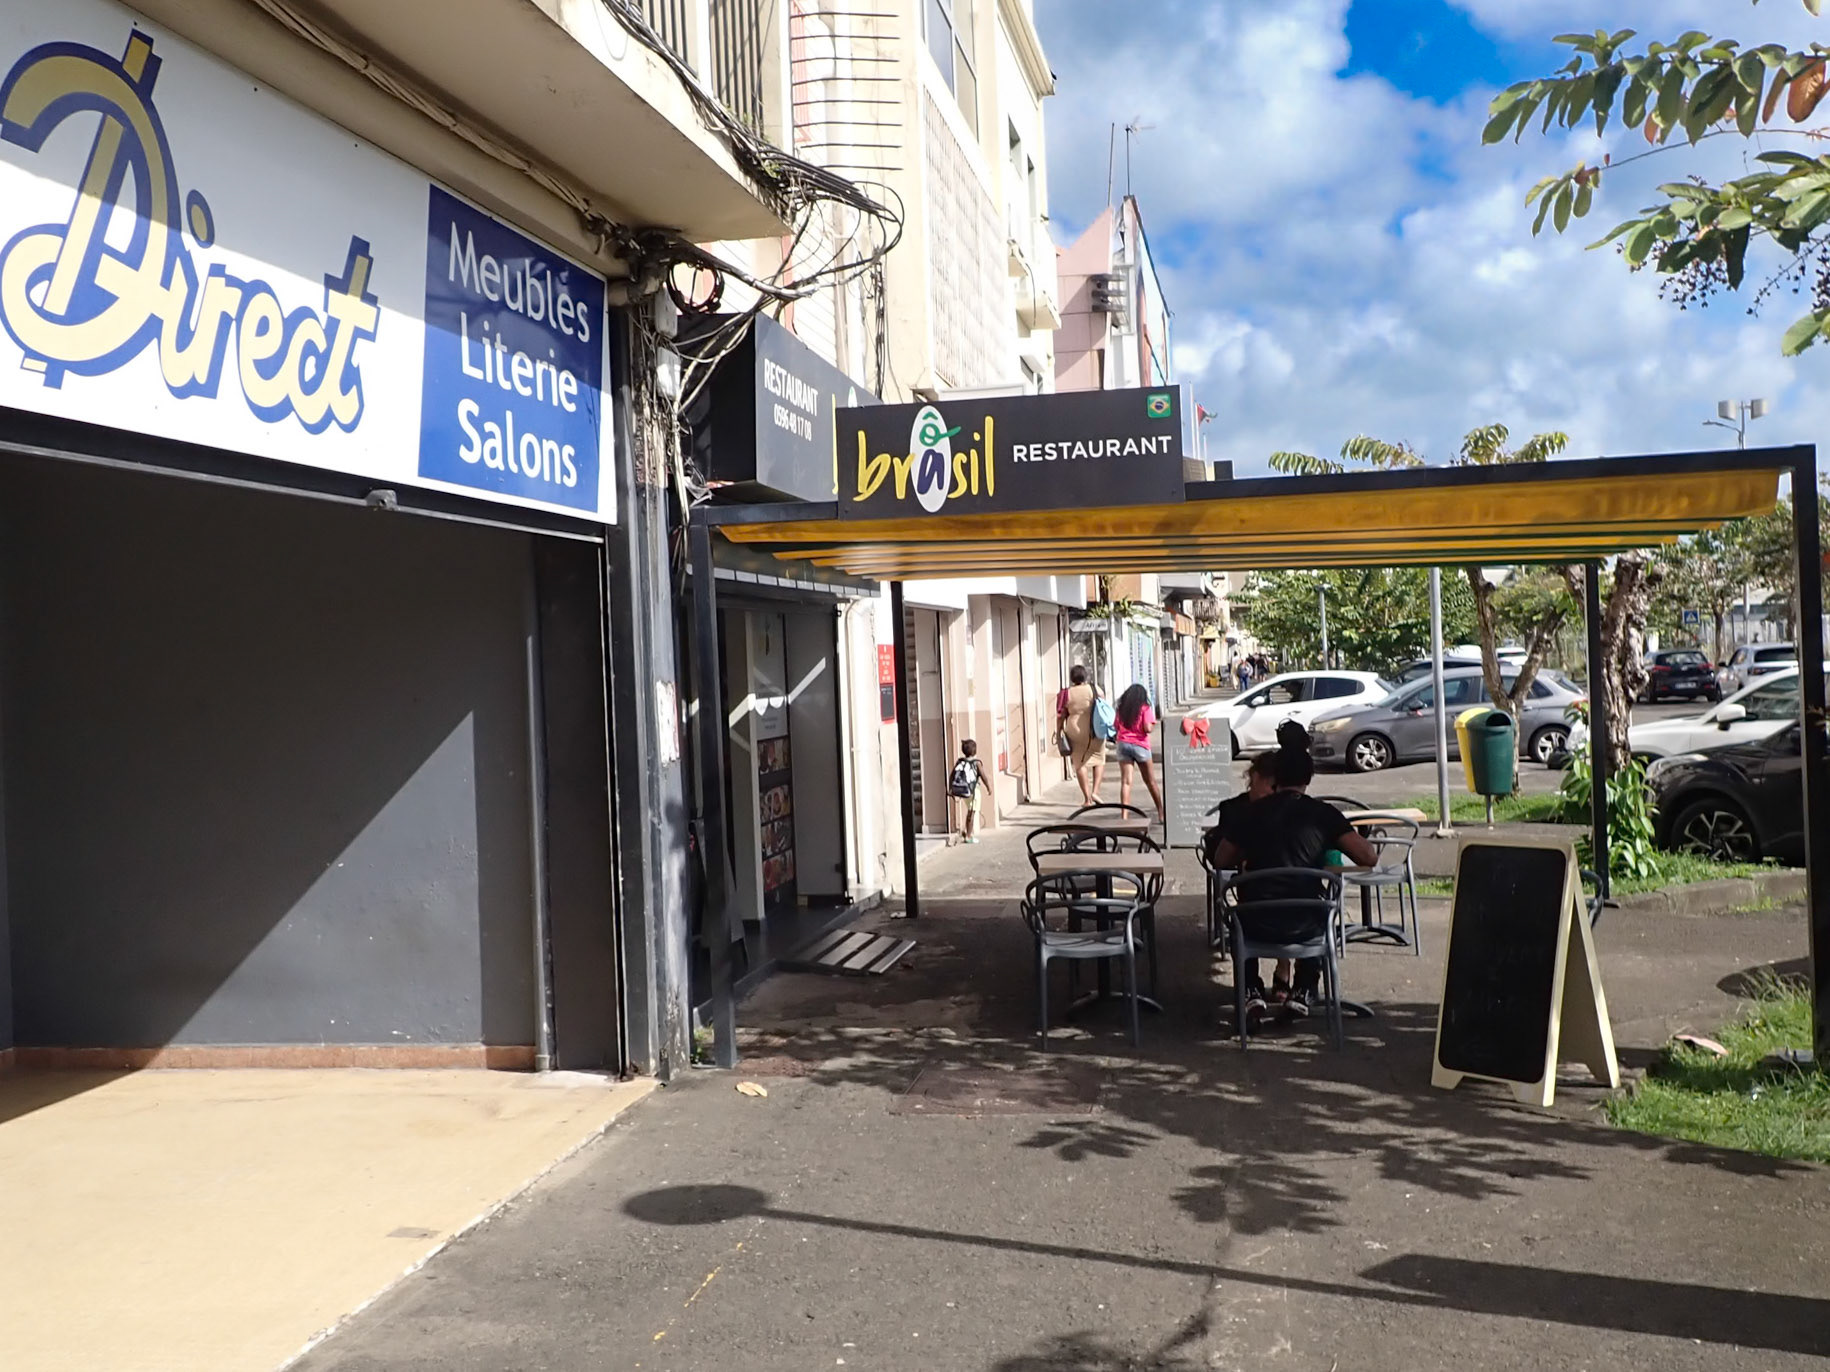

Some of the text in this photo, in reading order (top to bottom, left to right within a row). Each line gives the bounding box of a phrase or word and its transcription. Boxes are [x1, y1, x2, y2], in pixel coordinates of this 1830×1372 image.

[0, 29, 379, 435] Direct
[448, 220, 590, 343] Meublés
[460, 311, 579, 413] Literie
[763, 358, 819, 417] RESTAURANT
[458, 397, 578, 488] Salons
[852, 415, 996, 502] brasil
[1012, 435, 1173, 463] RESTAURANT
